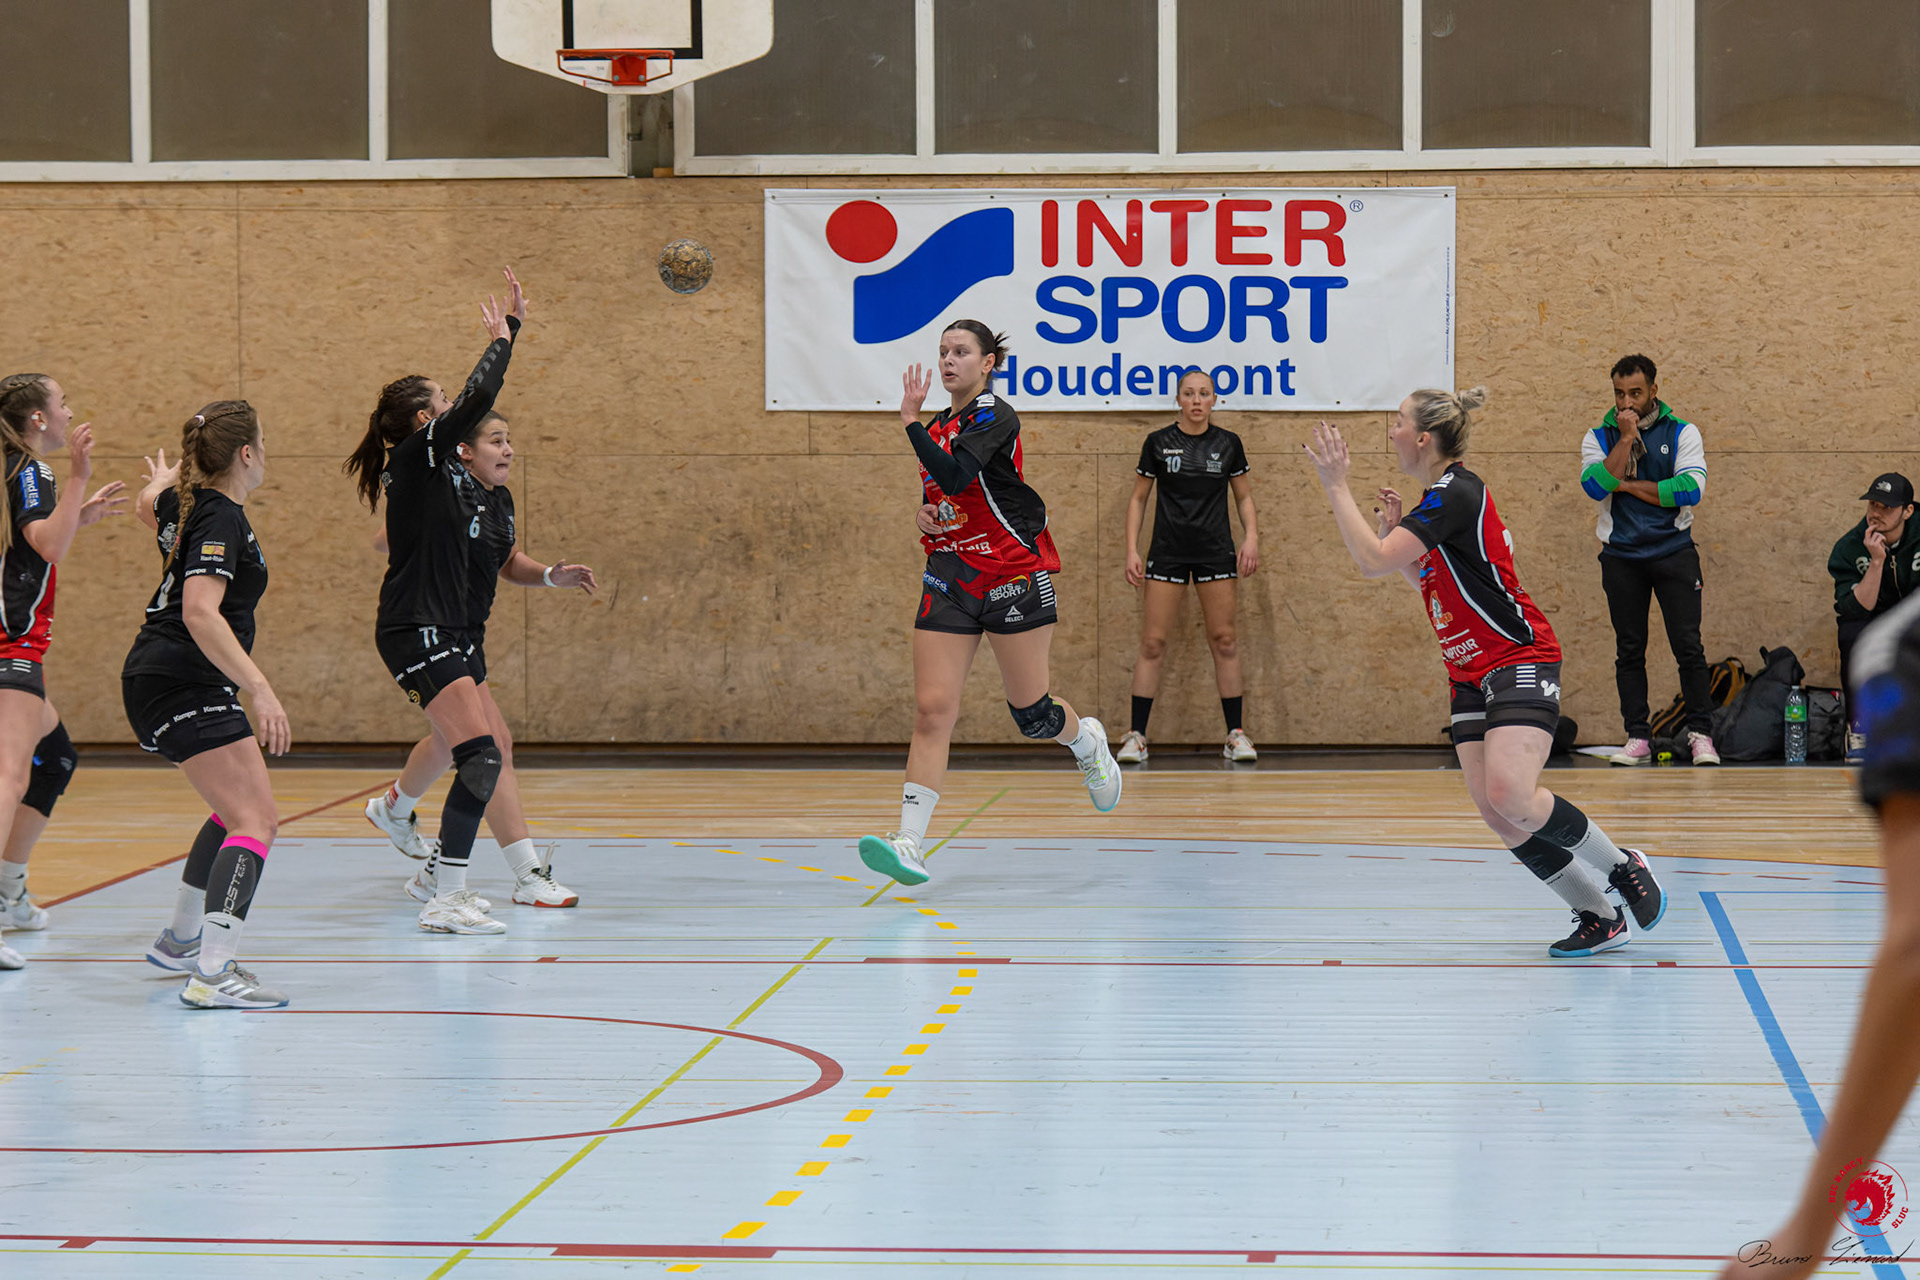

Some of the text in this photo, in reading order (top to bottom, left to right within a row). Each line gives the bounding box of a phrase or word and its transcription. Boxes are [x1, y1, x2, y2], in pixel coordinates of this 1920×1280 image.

[1042, 198, 1347, 268] INTER
[1035, 274, 1348, 344] SPORT
[988, 352, 1296, 396] Houdemont
[1164, 455, 1182, 473] 10
[469, 515, 480, 539] 6
[1004, 614, 1024, 623] SELECT
[418, 625, 439, 649] 77
[429, 650, 450, 663] Kempa
[1442, 638, 1479, 661] MPTOIR
[406, 661, 427, 674] Kempa
[173, 709, 197, 723] Kempa
[203, 705, 227, 713] Kempa
